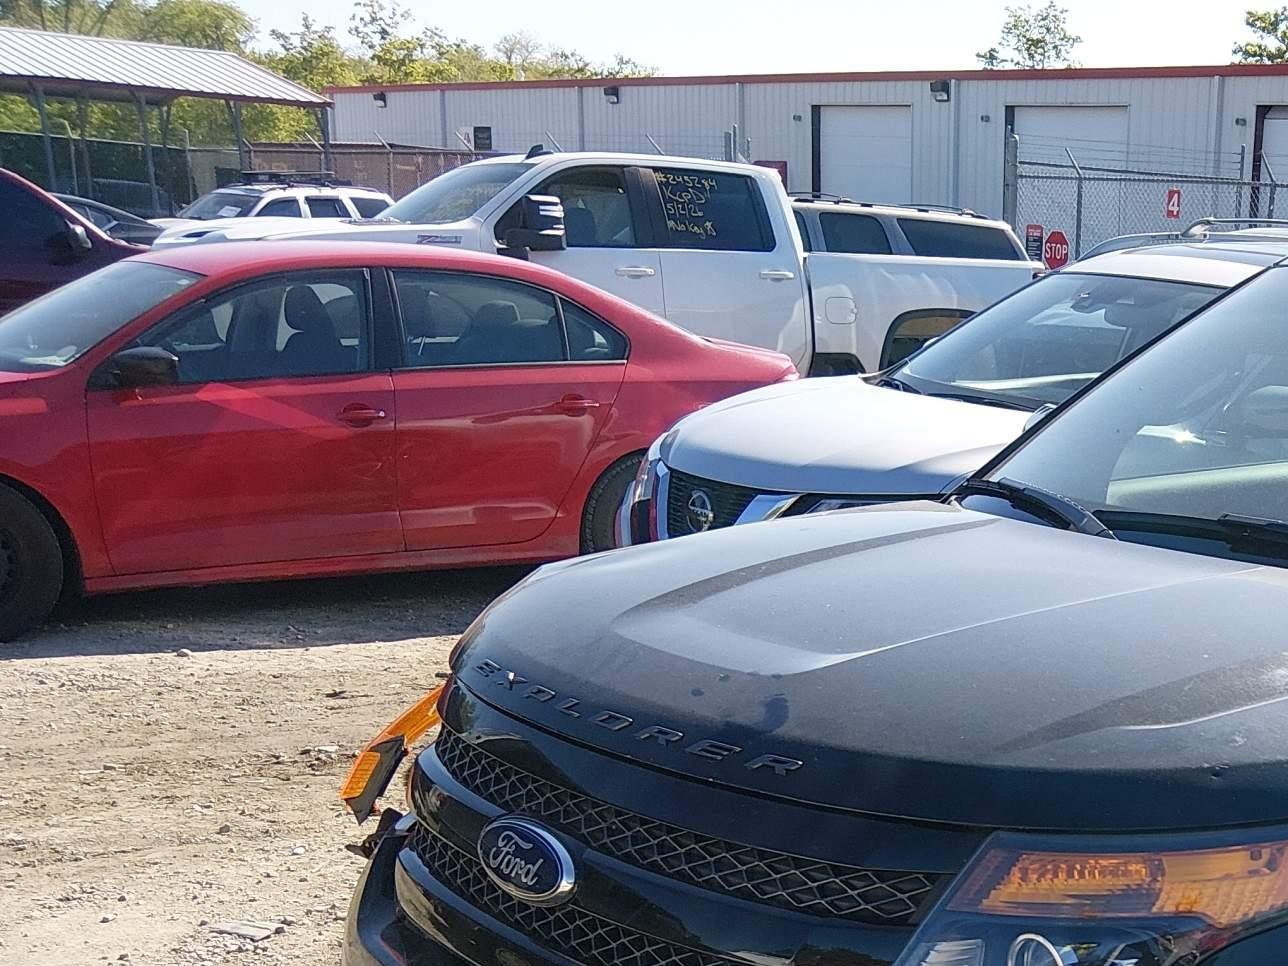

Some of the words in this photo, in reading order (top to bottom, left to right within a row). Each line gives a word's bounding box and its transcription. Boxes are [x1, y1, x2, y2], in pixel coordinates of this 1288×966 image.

[1168, 193, 1180, 216] 4
[1045, 242, 1068, 260] STOP
[473, 658, 804, 777] EXPLORER
[490, 831, 544, 887] Ford
